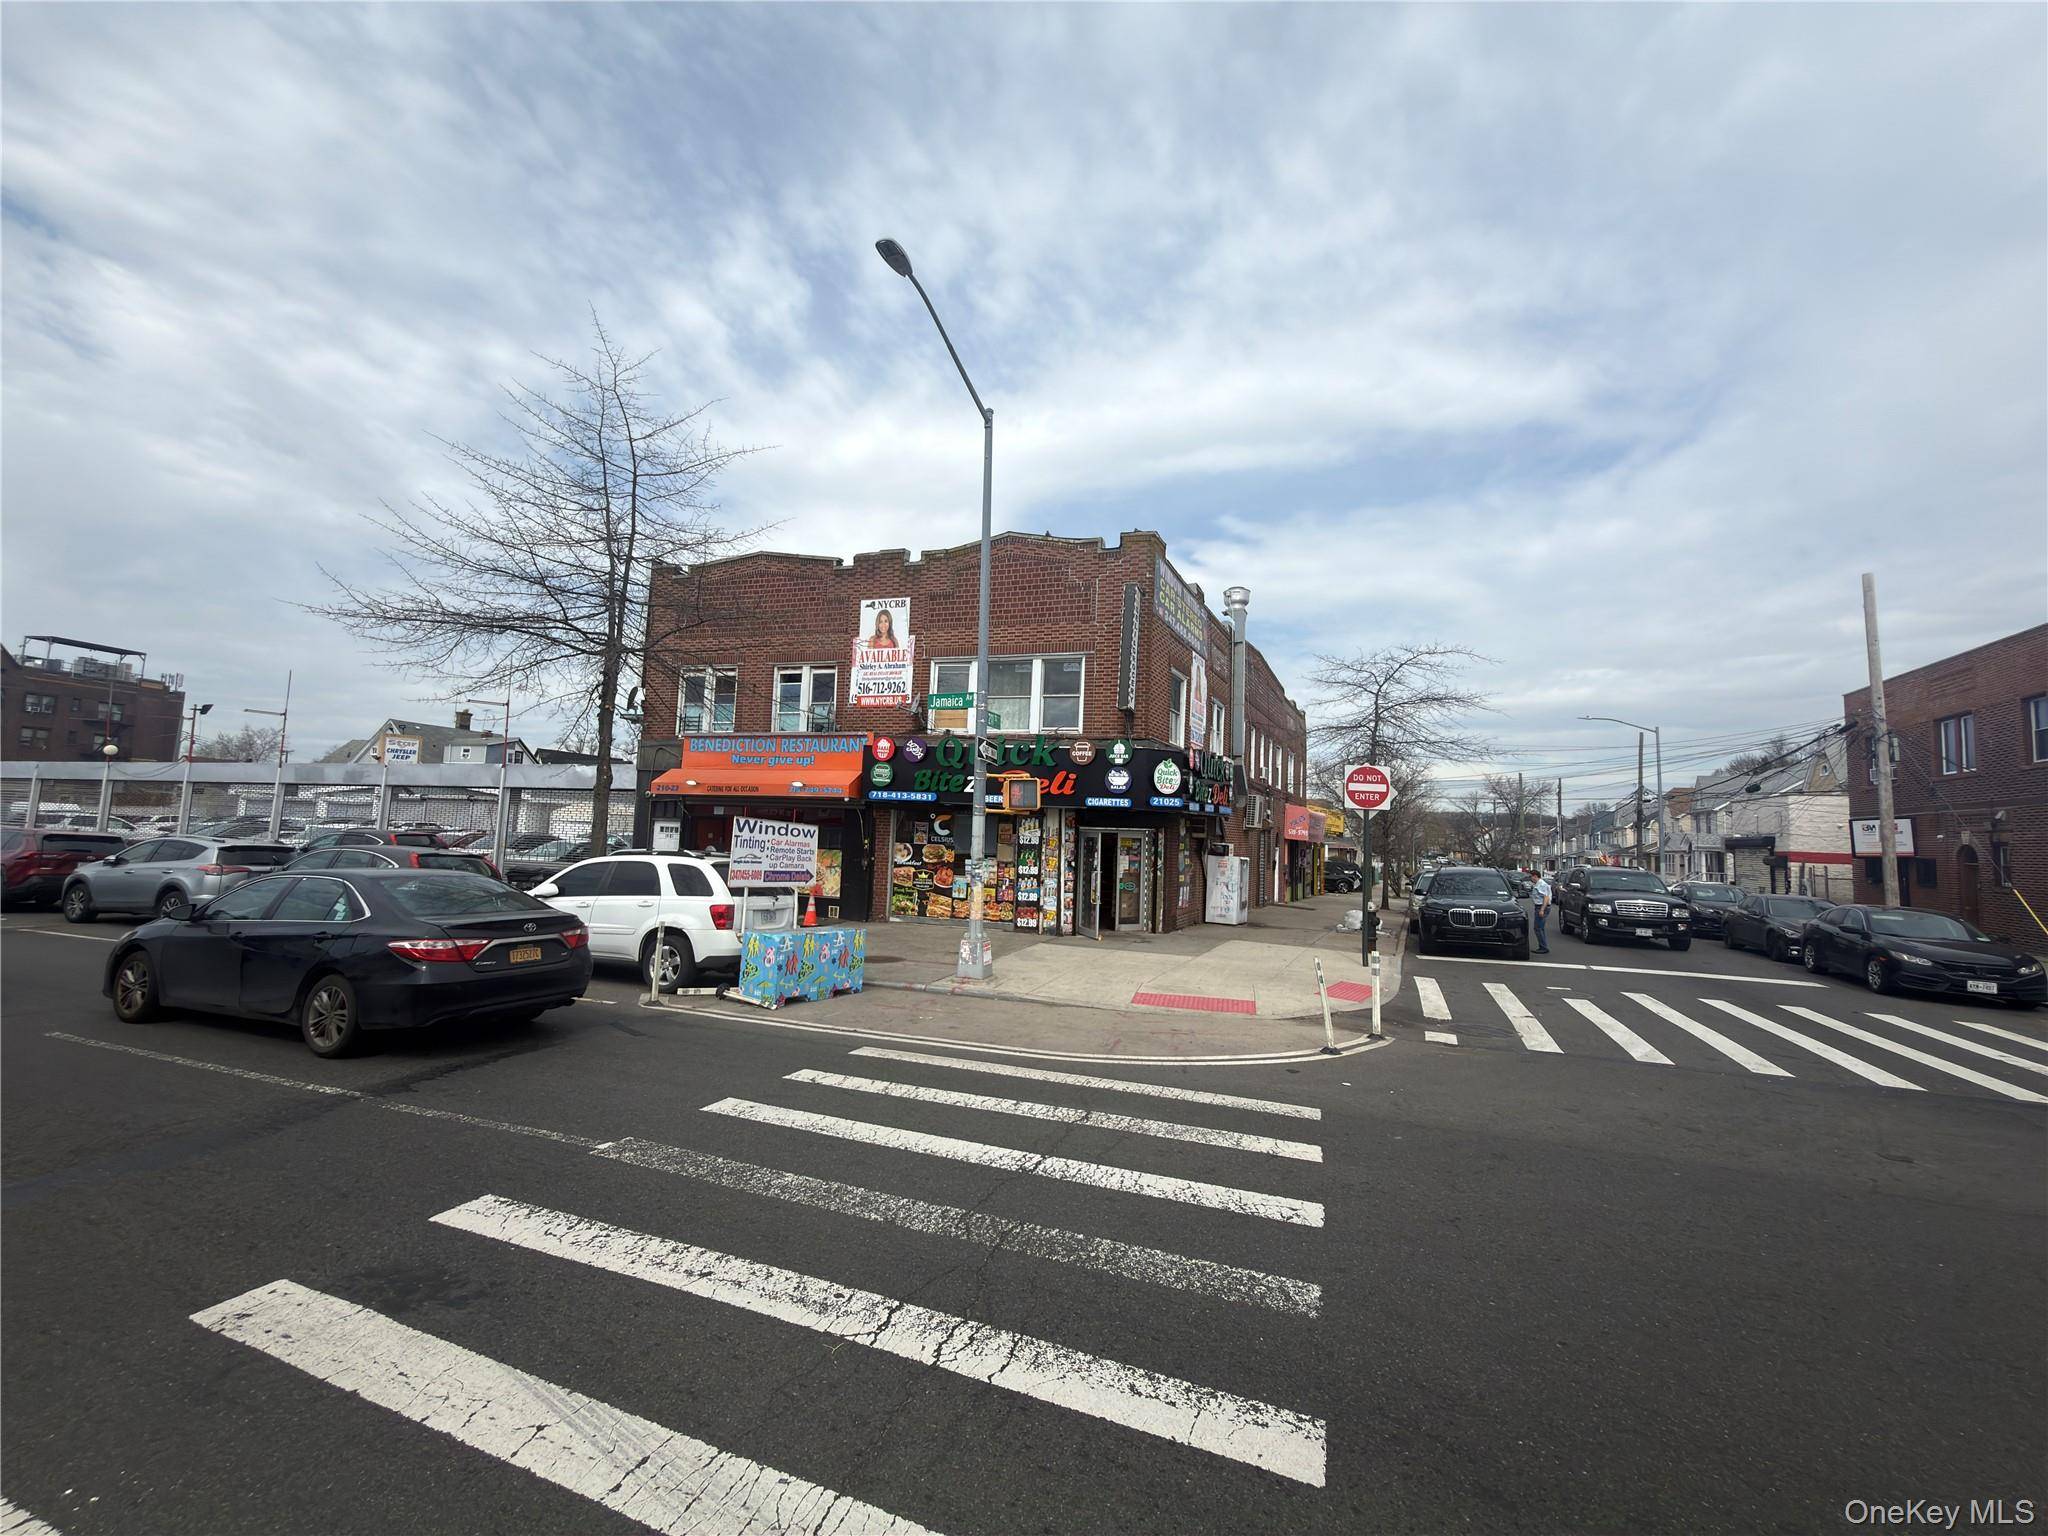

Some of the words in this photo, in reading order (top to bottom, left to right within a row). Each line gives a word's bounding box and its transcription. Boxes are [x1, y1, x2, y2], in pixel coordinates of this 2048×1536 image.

[877, 599, 907, 609] NYCRB
[859, 649, 908, 663] AVAILABLE
[857, 681, 906, 695] 516-712-9262
[930, 695, 963, 708] Jamaica
[690, 737, 776, 753] BENEDICTION
[781, 737, 869, 753] RESTAURANT
[386, 747, 417, 756] CHRYSLER
[731, 754, 766, 765] Never
[768, 754, 793, 767] give
[796, 755, 816, 767] up!
[1157, 768, 1178, 777] Quick
[1353, 774, 1364, 782] DO
[1366, 774, 1382, 783] NOT
[1159, 783, 1176, 791] Deli
[872, 791, 932, 801] 718-413-5831
[1354, 792, 1380, 801] ENTER
[1087, 798, 1129, 807] CIGARETTES
[1153, 797, 1180, 806] 21025
[735, 818, 816, 839] Window
[734, 834, 766, 853] Tinting
[770, 838, 783, 846] Car
[784, 839, 811, 848] Alarmas
[769, 845, 796, 854] Remote
[796, 847, 815, 855] Starts
[769, 853, 796, 863] CarPlay
[796, 854, 813, 862] Back
[768, 862, 778, 870] up
[779, 861, 805, 869] Camara
